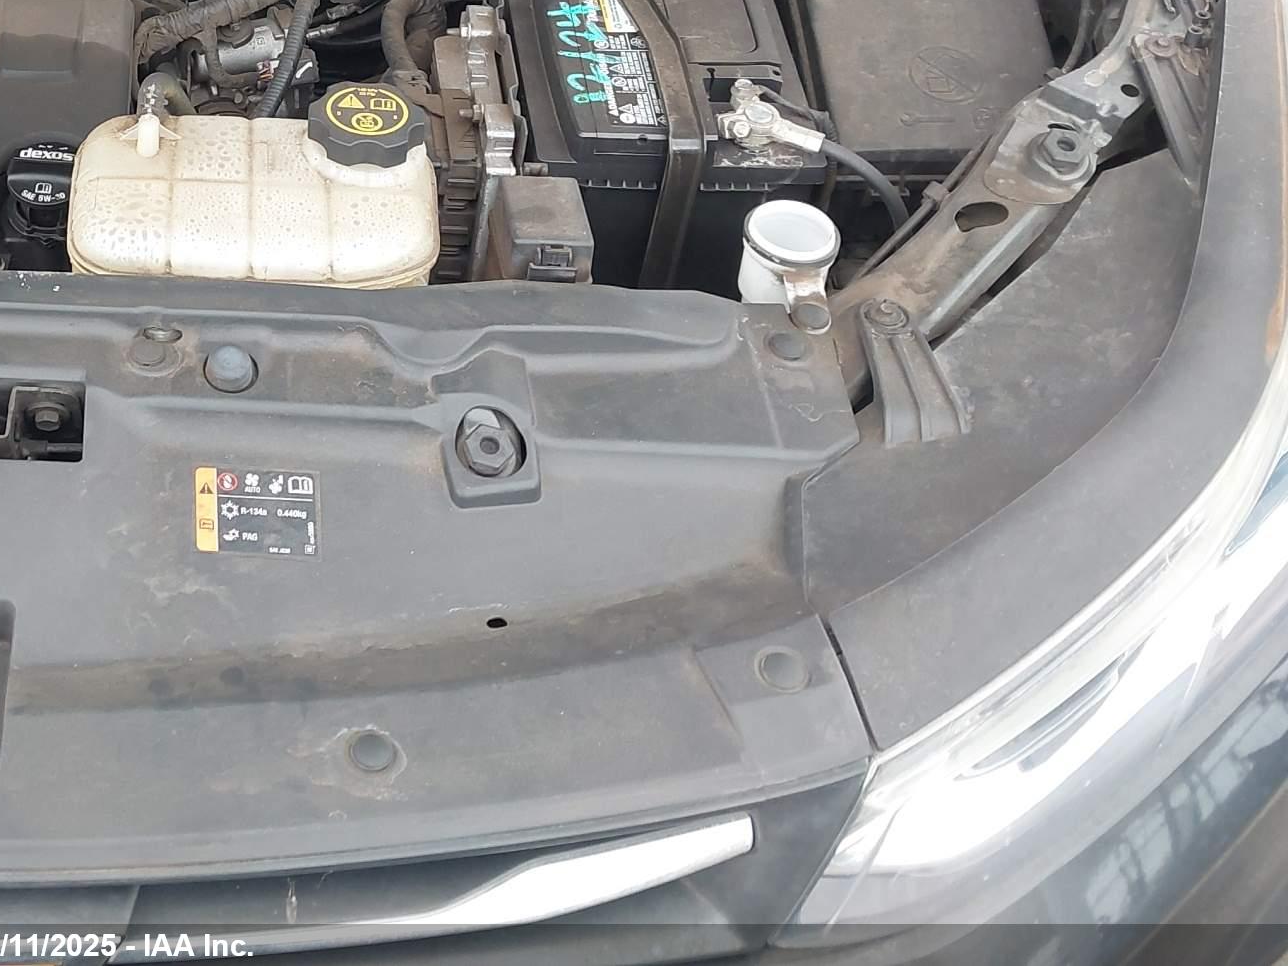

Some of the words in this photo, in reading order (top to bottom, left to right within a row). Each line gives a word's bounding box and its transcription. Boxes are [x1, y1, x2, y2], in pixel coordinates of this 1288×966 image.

[19, 147, 74, 161] dexos
[21, 189, 36, 201] SAE
[277, 508, 307, 519] 0.440kg
[242, 532, 258, 541] PAG
